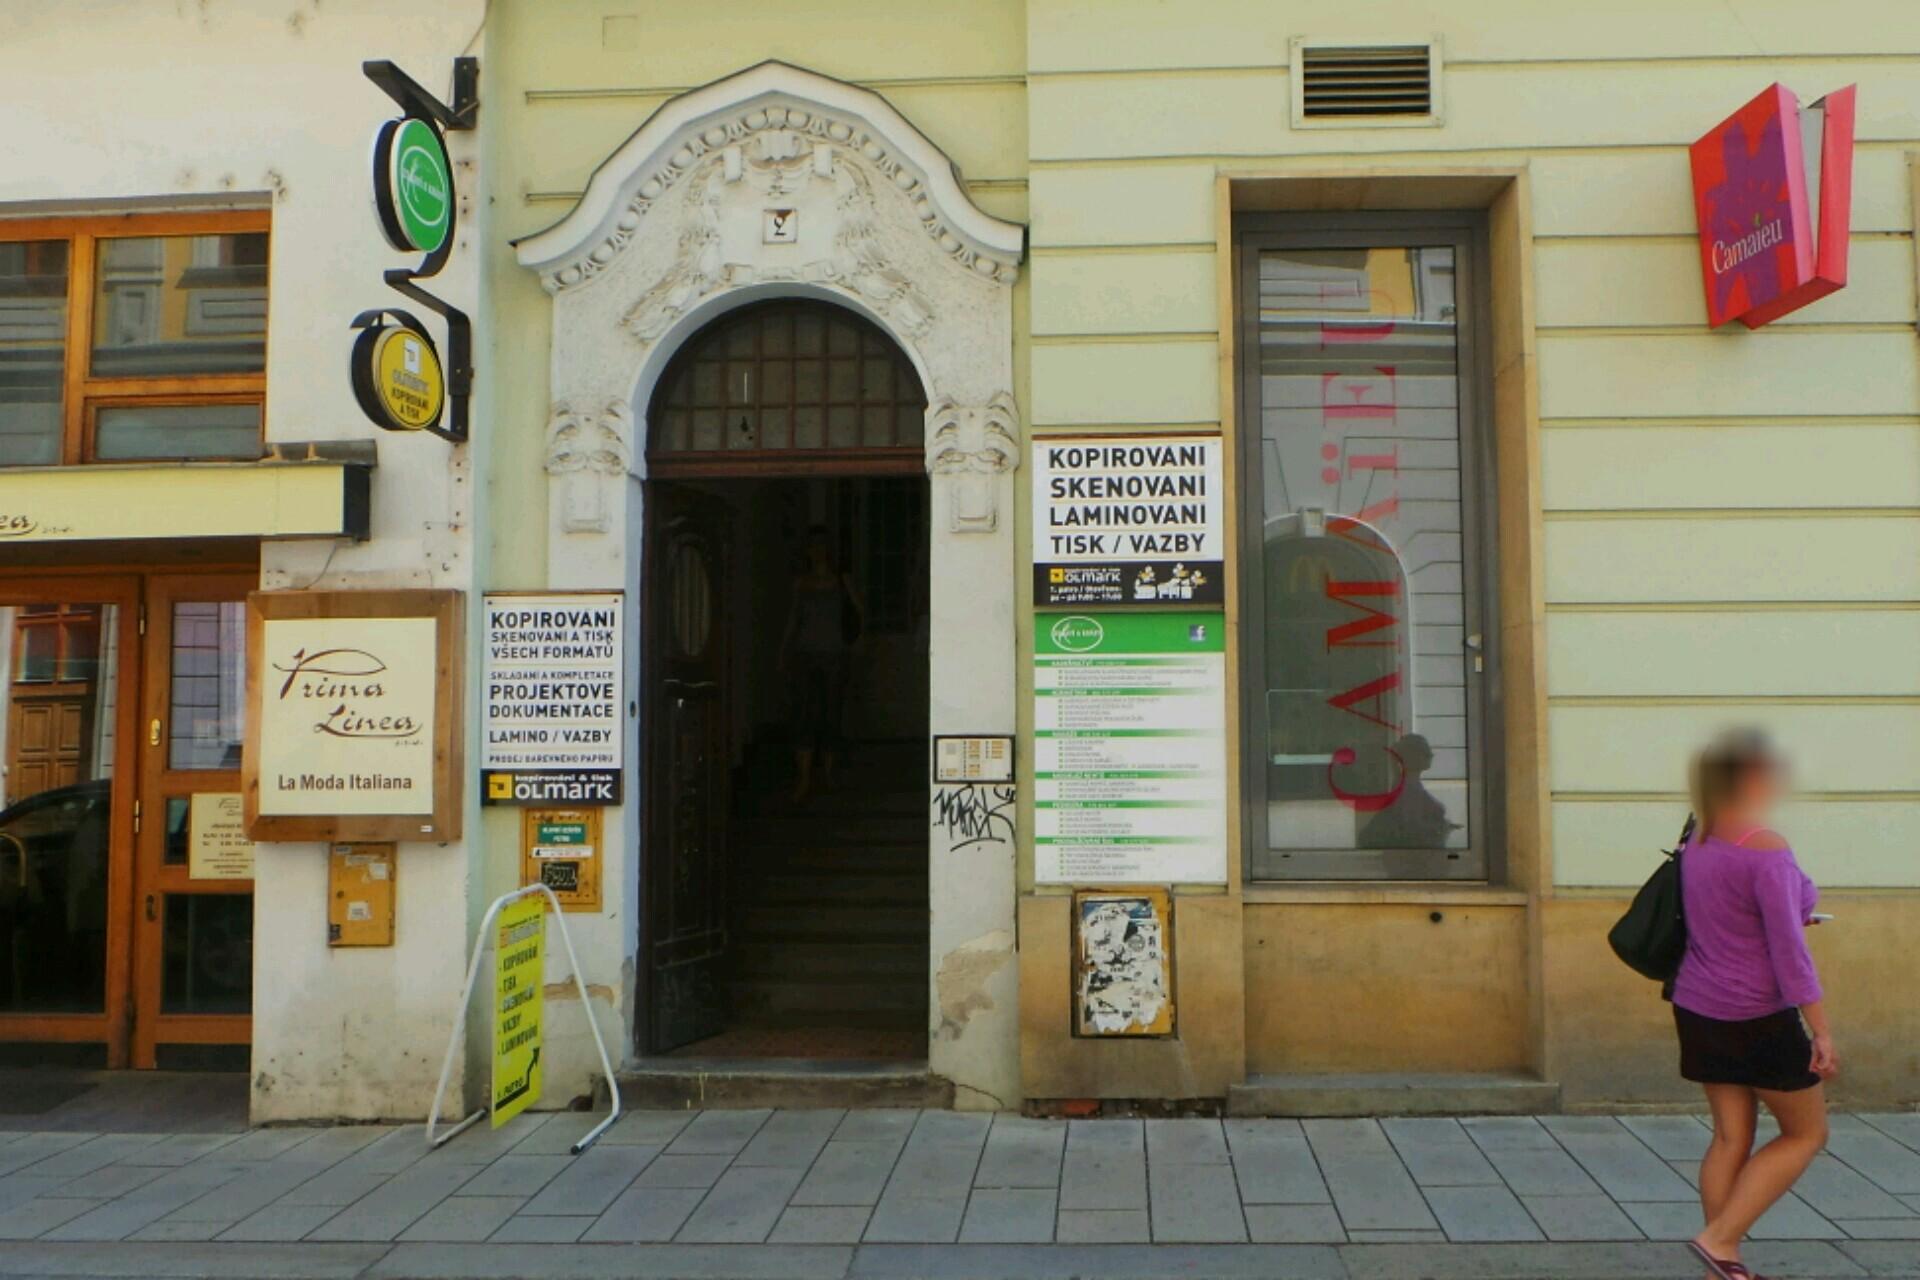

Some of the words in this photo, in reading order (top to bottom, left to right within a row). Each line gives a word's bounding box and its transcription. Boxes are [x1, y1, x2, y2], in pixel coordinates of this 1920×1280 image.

[1050, 535, 1105, 554] TISK
[1129, 533, 1205, 554] VAZBY
[571, 631, 580, 641] A
[584, 630, 614, 641] TISK
[272, 648, 387, 700] Prima
[489, 704, 614, 718] DOKUMENTACE
[313, 703, 424, 738] Linea
[489, 730, 549, 743] LAMINO
[562, 730, 612, 743] VAZBY
[278, 774, 296, 790] La
[300, 774, 345, 790] Moda
[350, 774, 412, 790] Italiana
